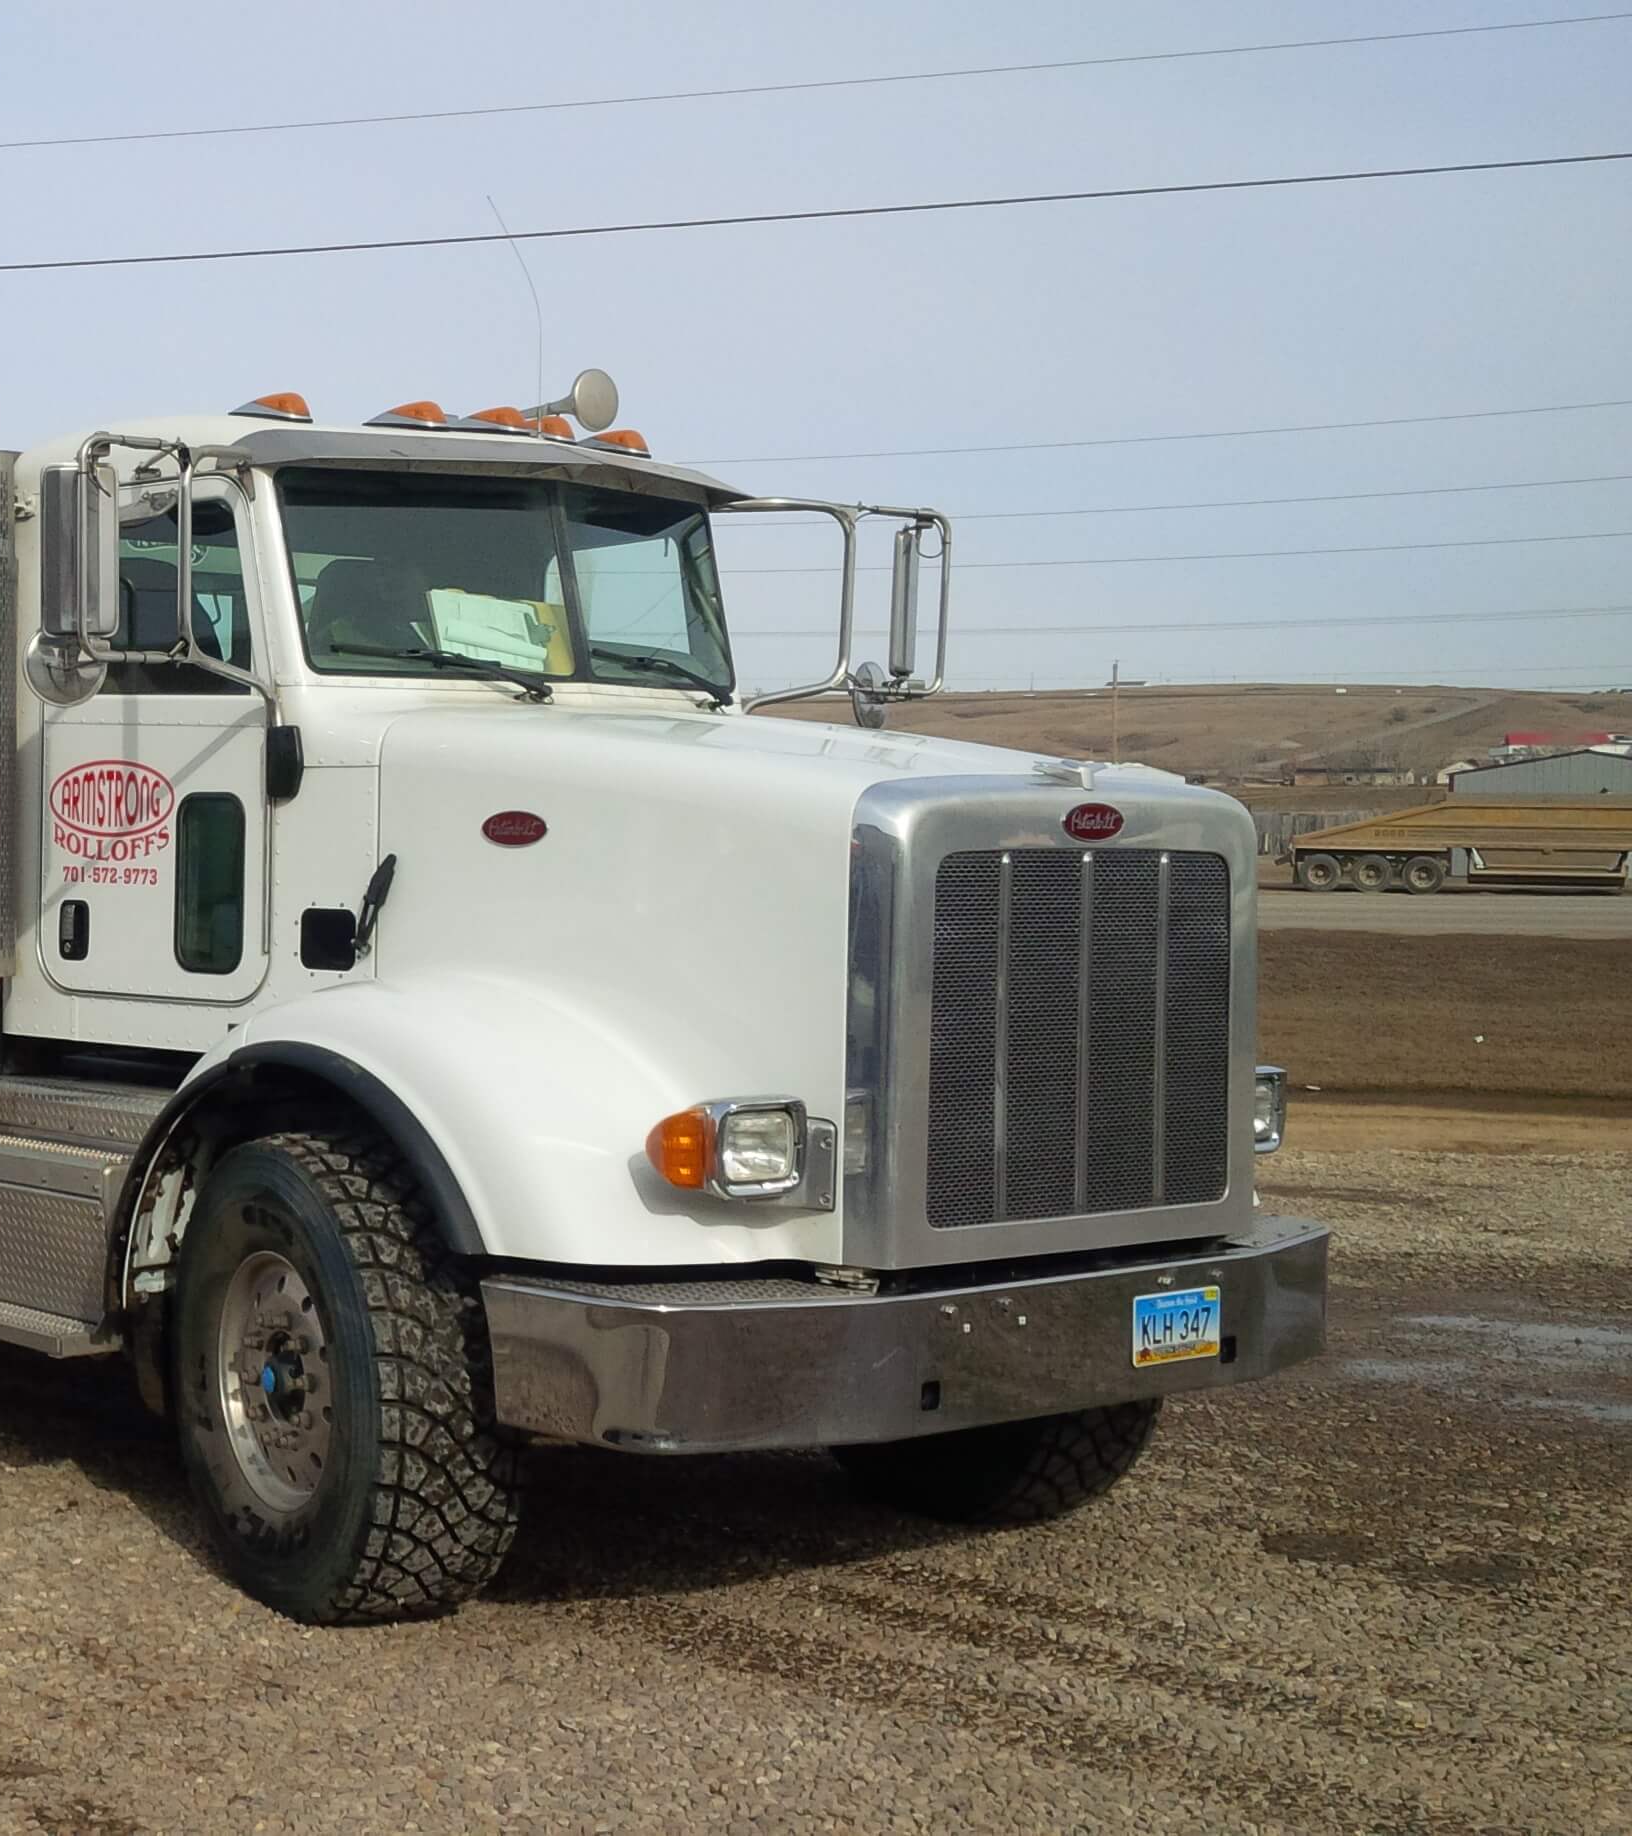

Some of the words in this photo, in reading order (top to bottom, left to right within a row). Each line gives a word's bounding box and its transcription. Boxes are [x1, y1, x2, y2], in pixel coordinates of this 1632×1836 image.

[61, 769, 161, 827] ARMSTRONG
[1072, 809, 1120, 831] Peterbilt
[54, 822, 170, 861] ROLLOFFS
[63, 865, 158, 886] 701-572-9773
[1142, 1312, 1174, 1347] KLH
[1179, 1307, 1212, 1341] 347
